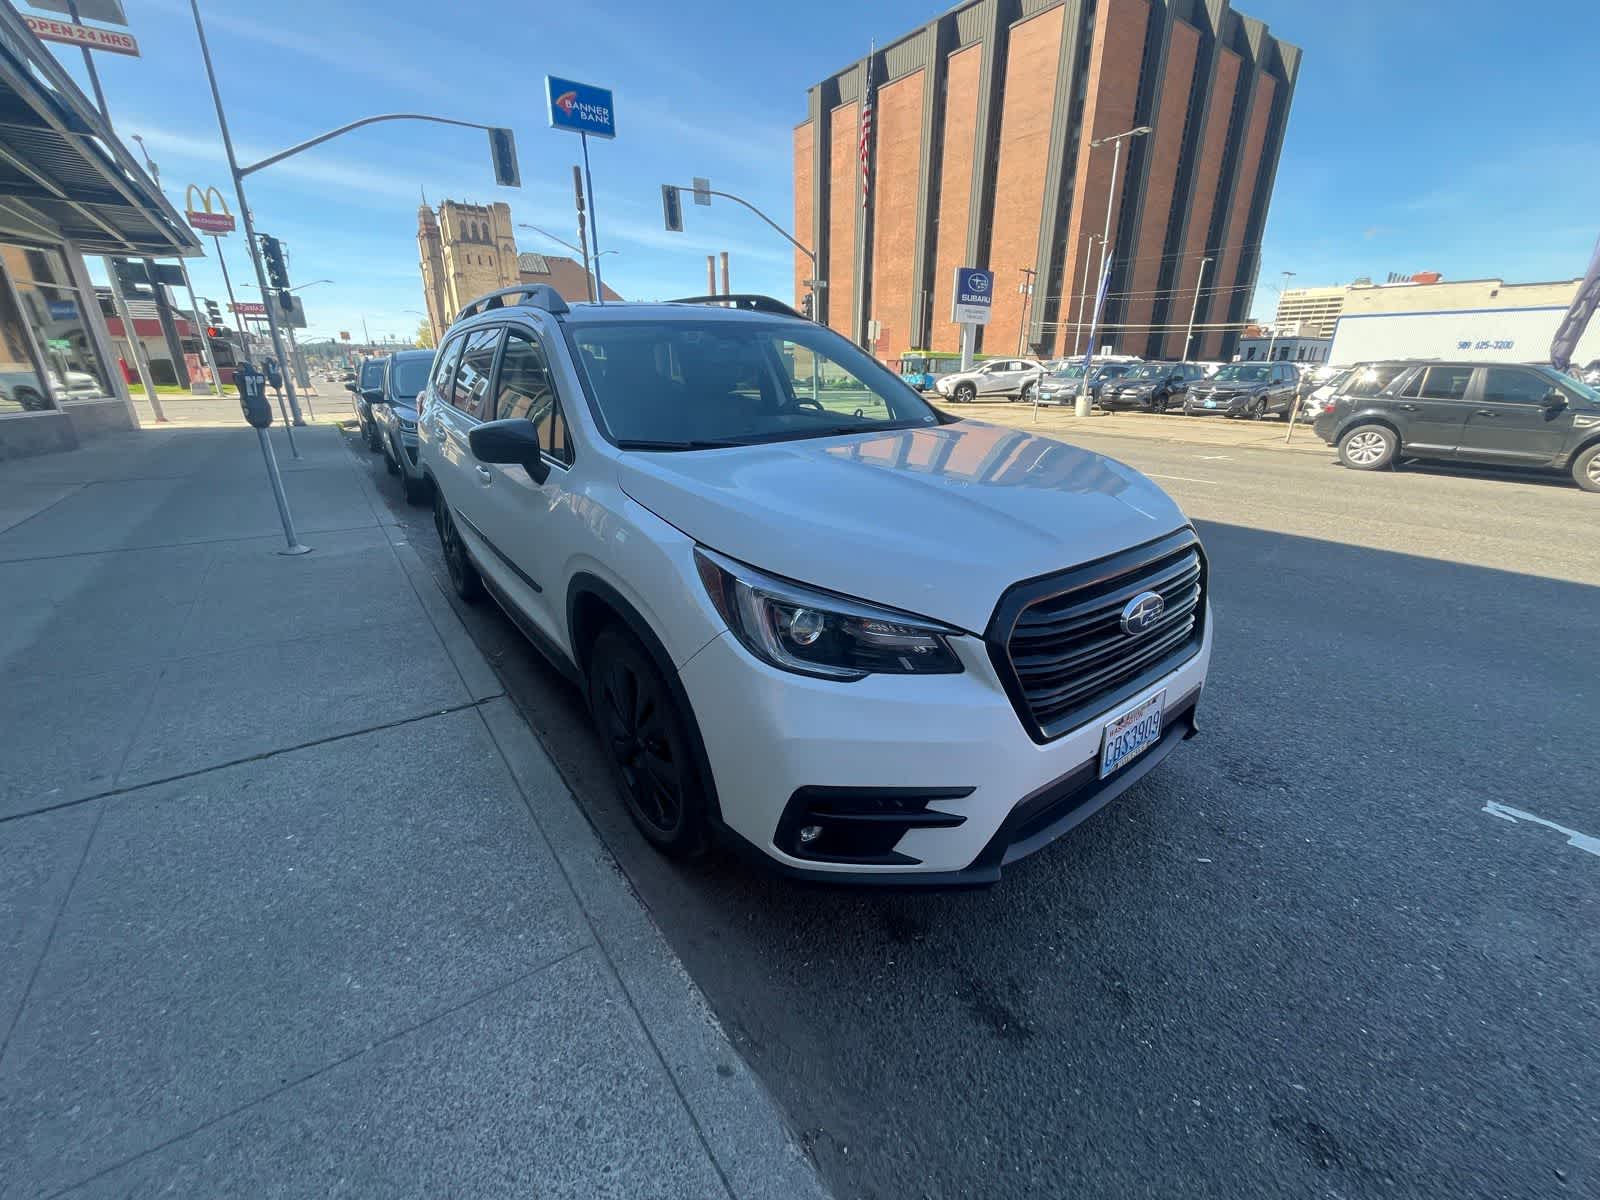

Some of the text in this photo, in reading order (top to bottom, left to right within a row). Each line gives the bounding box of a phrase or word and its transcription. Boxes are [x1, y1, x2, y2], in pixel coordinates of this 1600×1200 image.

[28, 19, 132, 48] OPEN 24 HRS
[565, 99, 609, 116] BANNER
[580, 111, 611, 126] BANK
[961, 293, 991, 304] SUBARU
